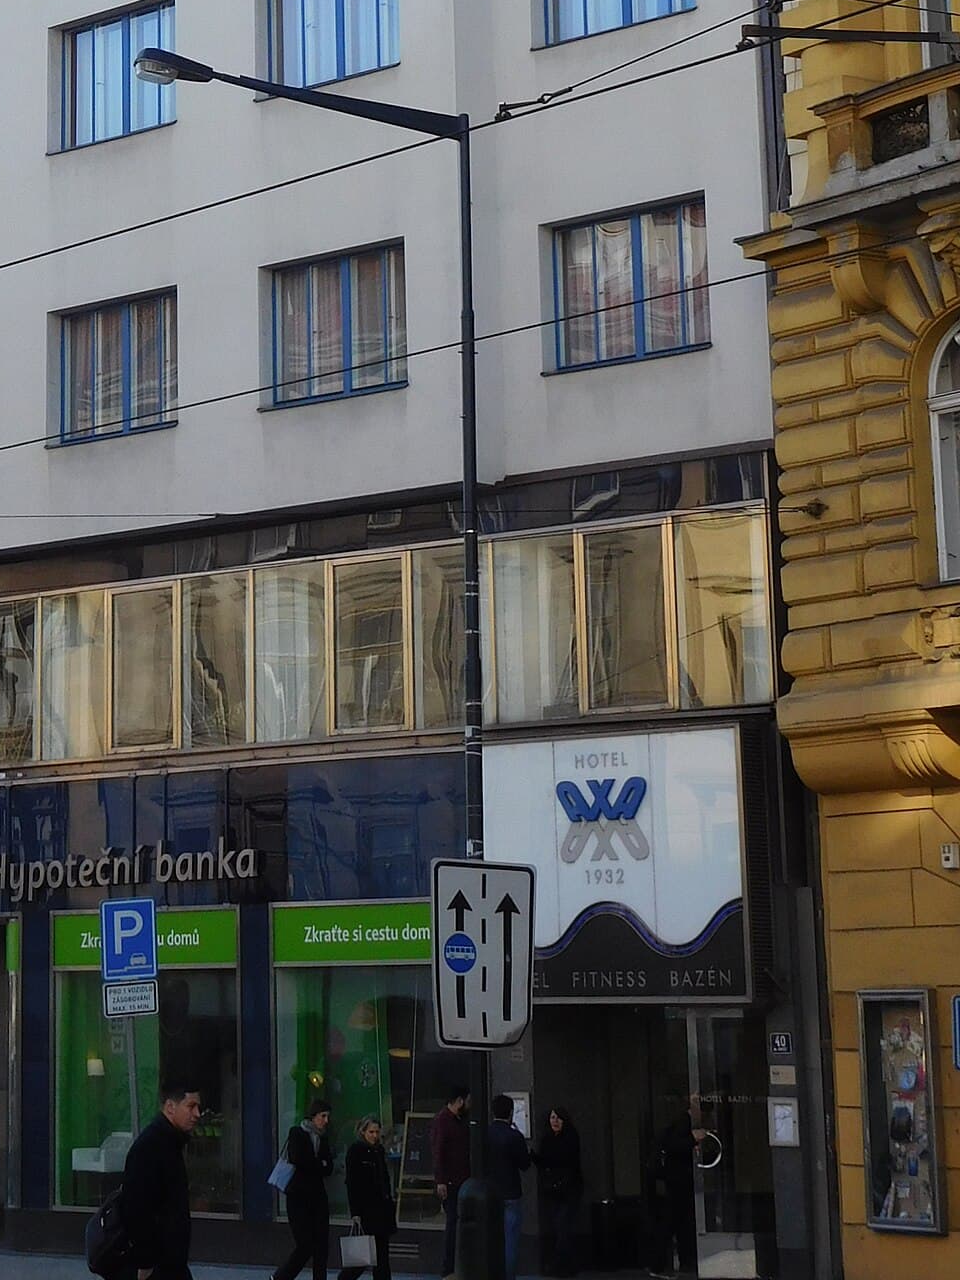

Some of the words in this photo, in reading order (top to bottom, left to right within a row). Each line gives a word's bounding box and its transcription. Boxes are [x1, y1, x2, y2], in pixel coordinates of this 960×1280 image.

[574, 751, 629, 769] HOTEL
[556, 776, 648, 823] AXA
[155, 836, 258, 883] banka
[585, 868, 625, 885] 1932
[114, 909, 143, 955] P
[167, 929, 200, 946] domů
[303, 924, 350, 943] Zkraťte
[352, 924, 363, 942] si
[365, 925, 399, 942] cestu
[401, 923, 431, 941] dom
[571, 969, 647, 989] FITNESS
[669, 966, 732, 988] BAZÉN
[774, 1035, 786, 1047] 40
